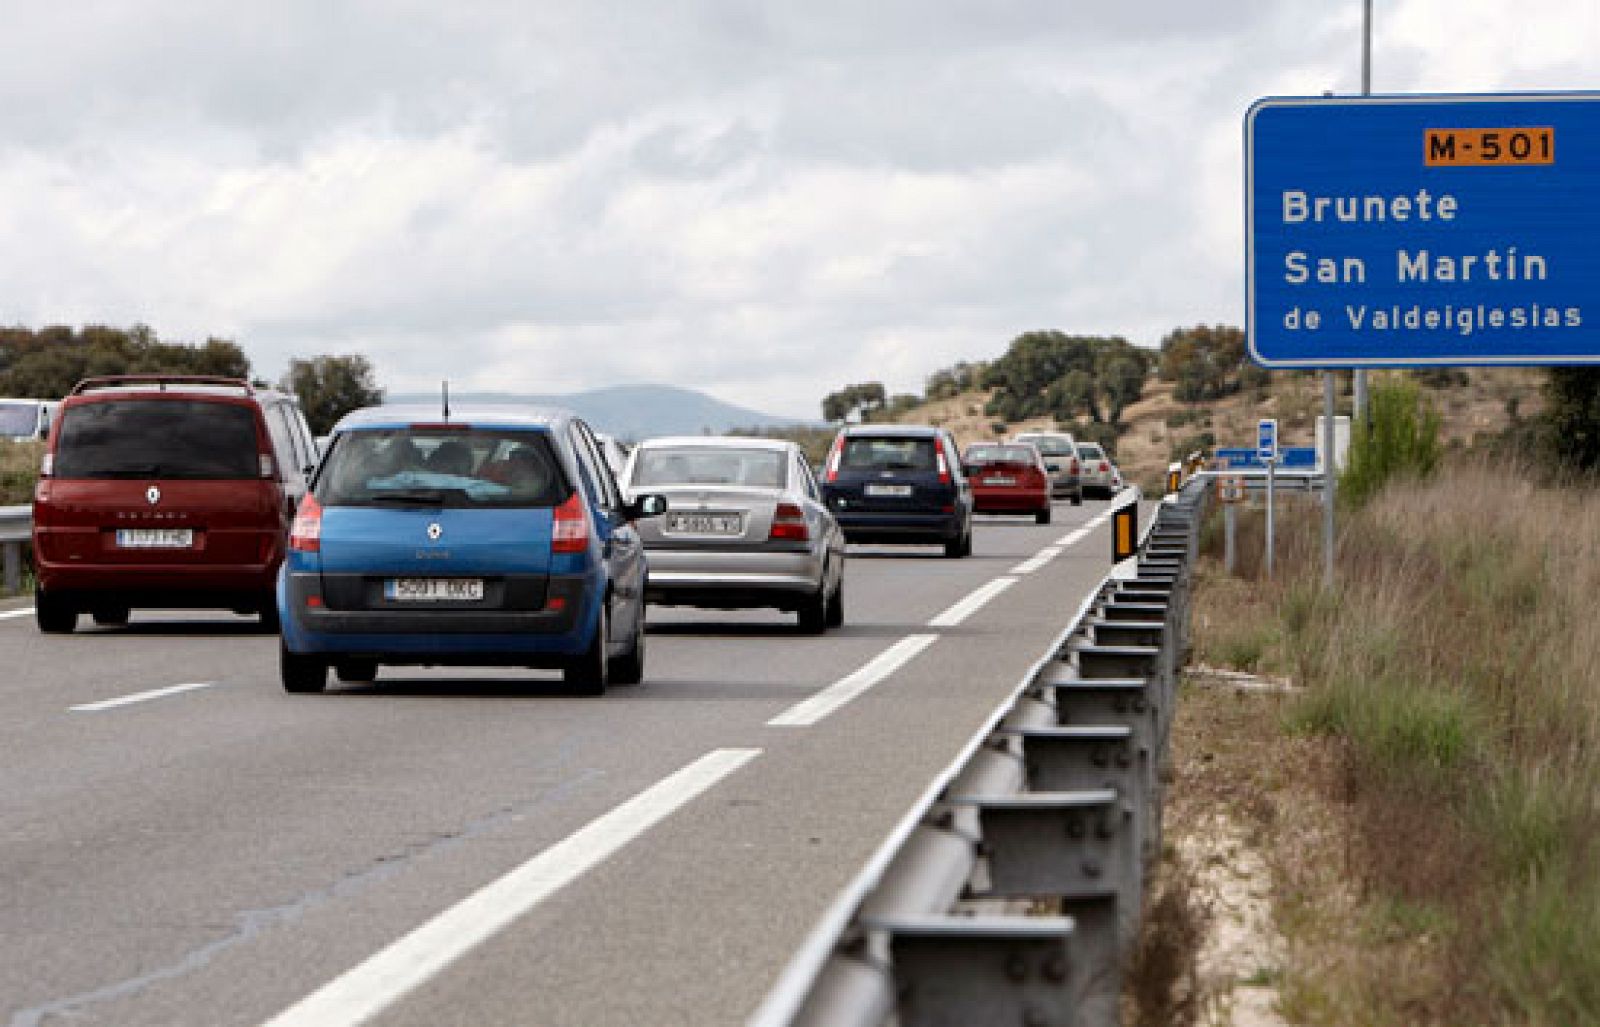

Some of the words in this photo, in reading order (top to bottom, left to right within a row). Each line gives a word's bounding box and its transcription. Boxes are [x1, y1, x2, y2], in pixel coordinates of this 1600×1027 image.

[1431, 132, 1548, 160] M-501
[1283, 189, 1457, 221] Brunete
[1285, 251, 1366, 282] San
[1285, 306, 1320, 329] de
[1347, 305, 1582, 335] Valdeiglesias
